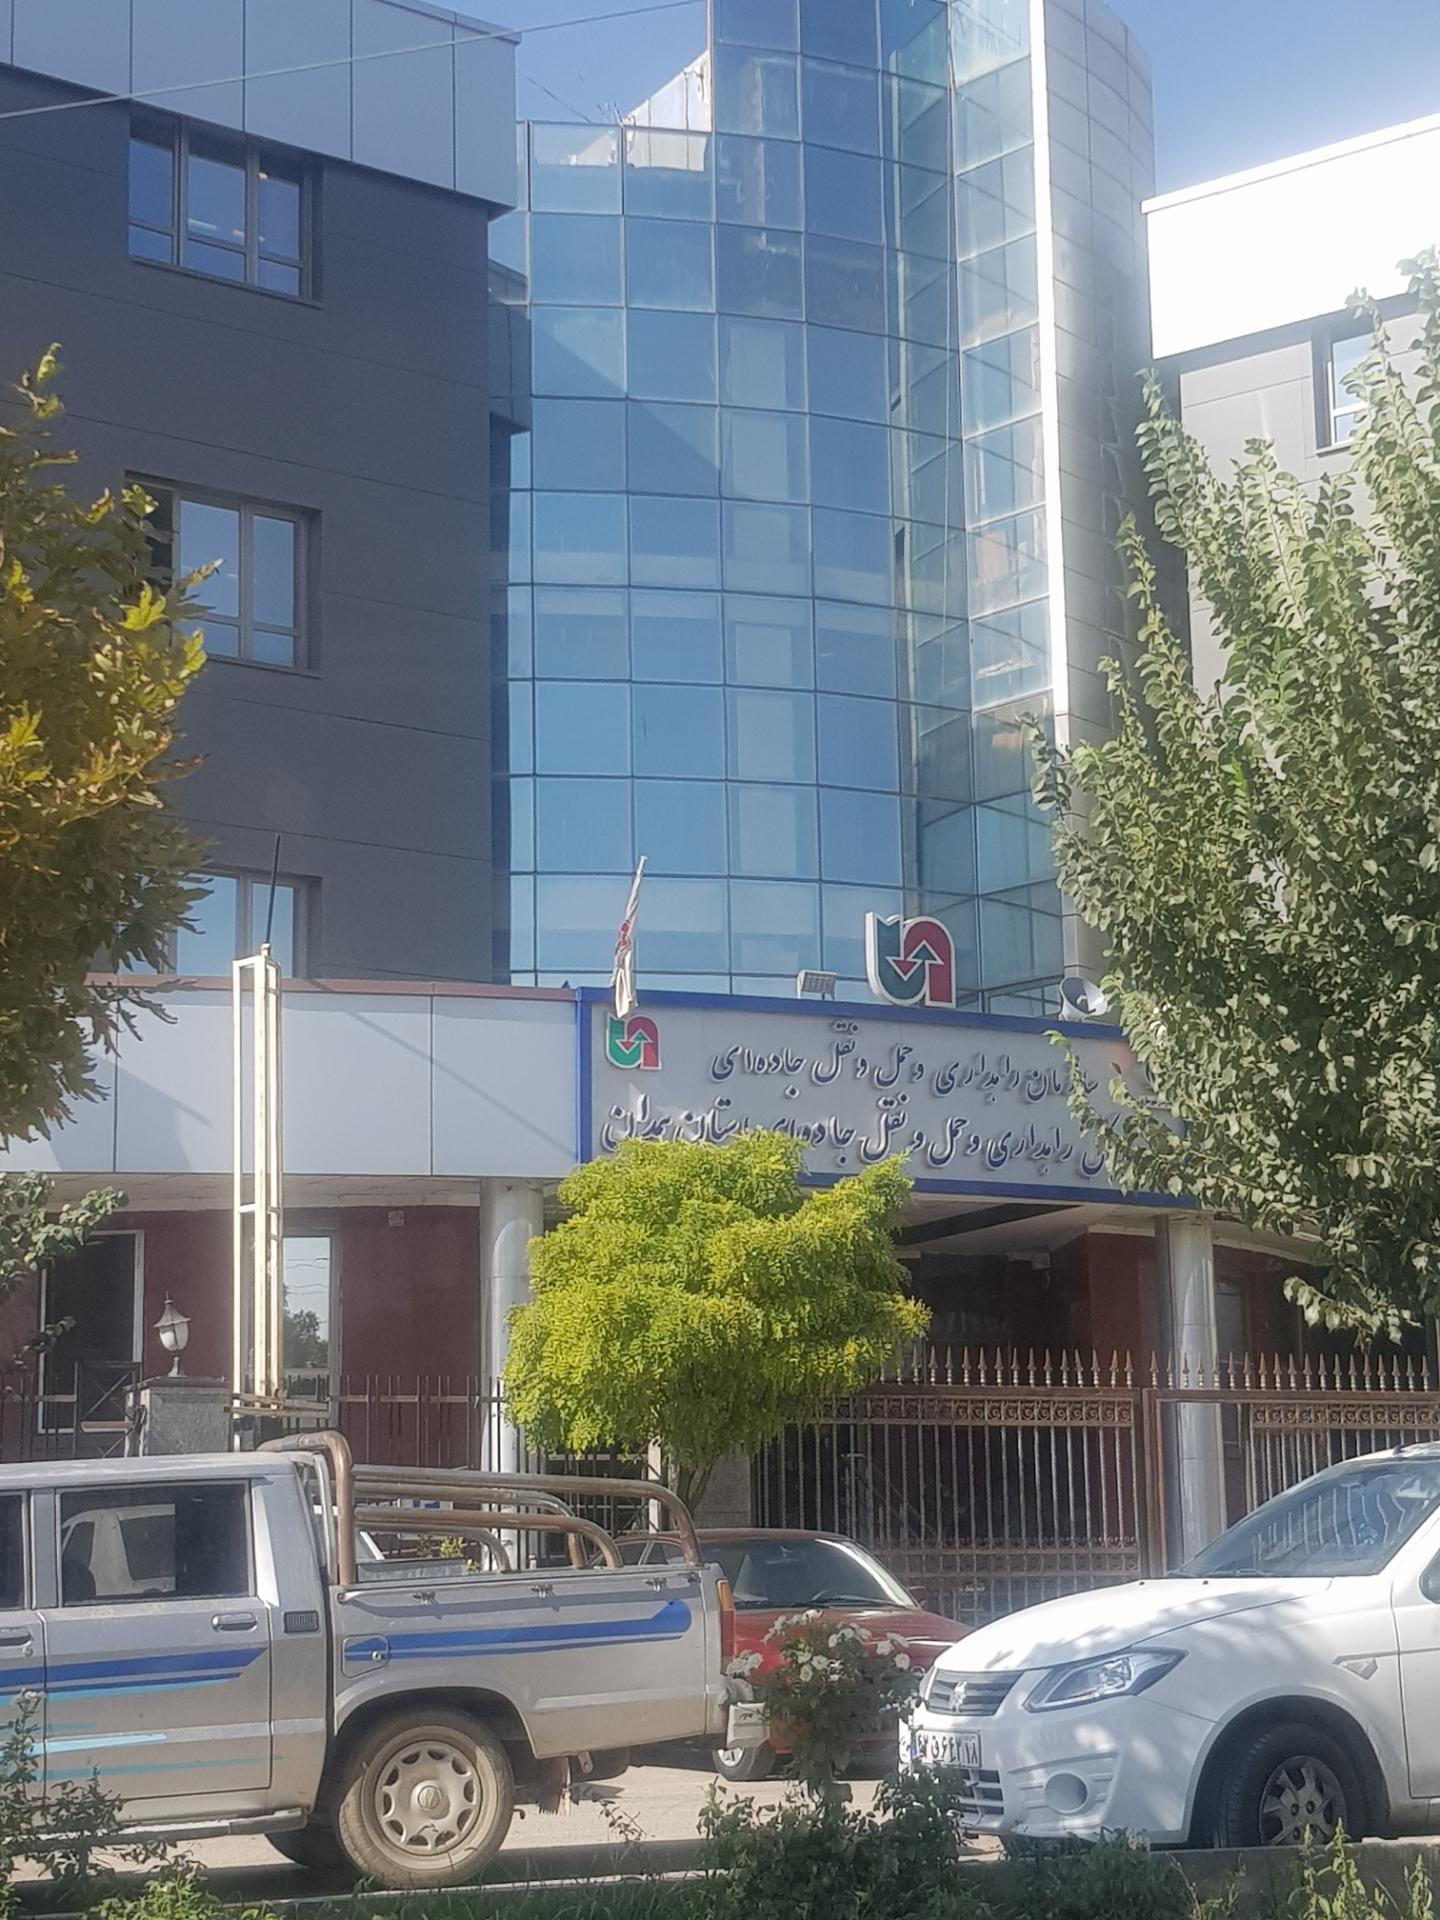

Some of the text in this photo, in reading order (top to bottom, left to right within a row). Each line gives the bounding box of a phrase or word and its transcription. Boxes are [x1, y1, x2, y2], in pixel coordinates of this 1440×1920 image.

[813, 1021, 858, 1083] نقل
[856, 1057, 868, 1077] و
[875, 1044, 913, 1087] حمل
[914, 1062, 925, 1081] و
[935, 1054, 1020, 1102] راهداری
[862, 1093, 908, 1162] نقل
[912, 1130, 924, 1150] و
[928, 1117, 968, 1166] حمل
[968, 1134, 980, 1155] و
[988, 1123, 1073, 1174] راهداری
